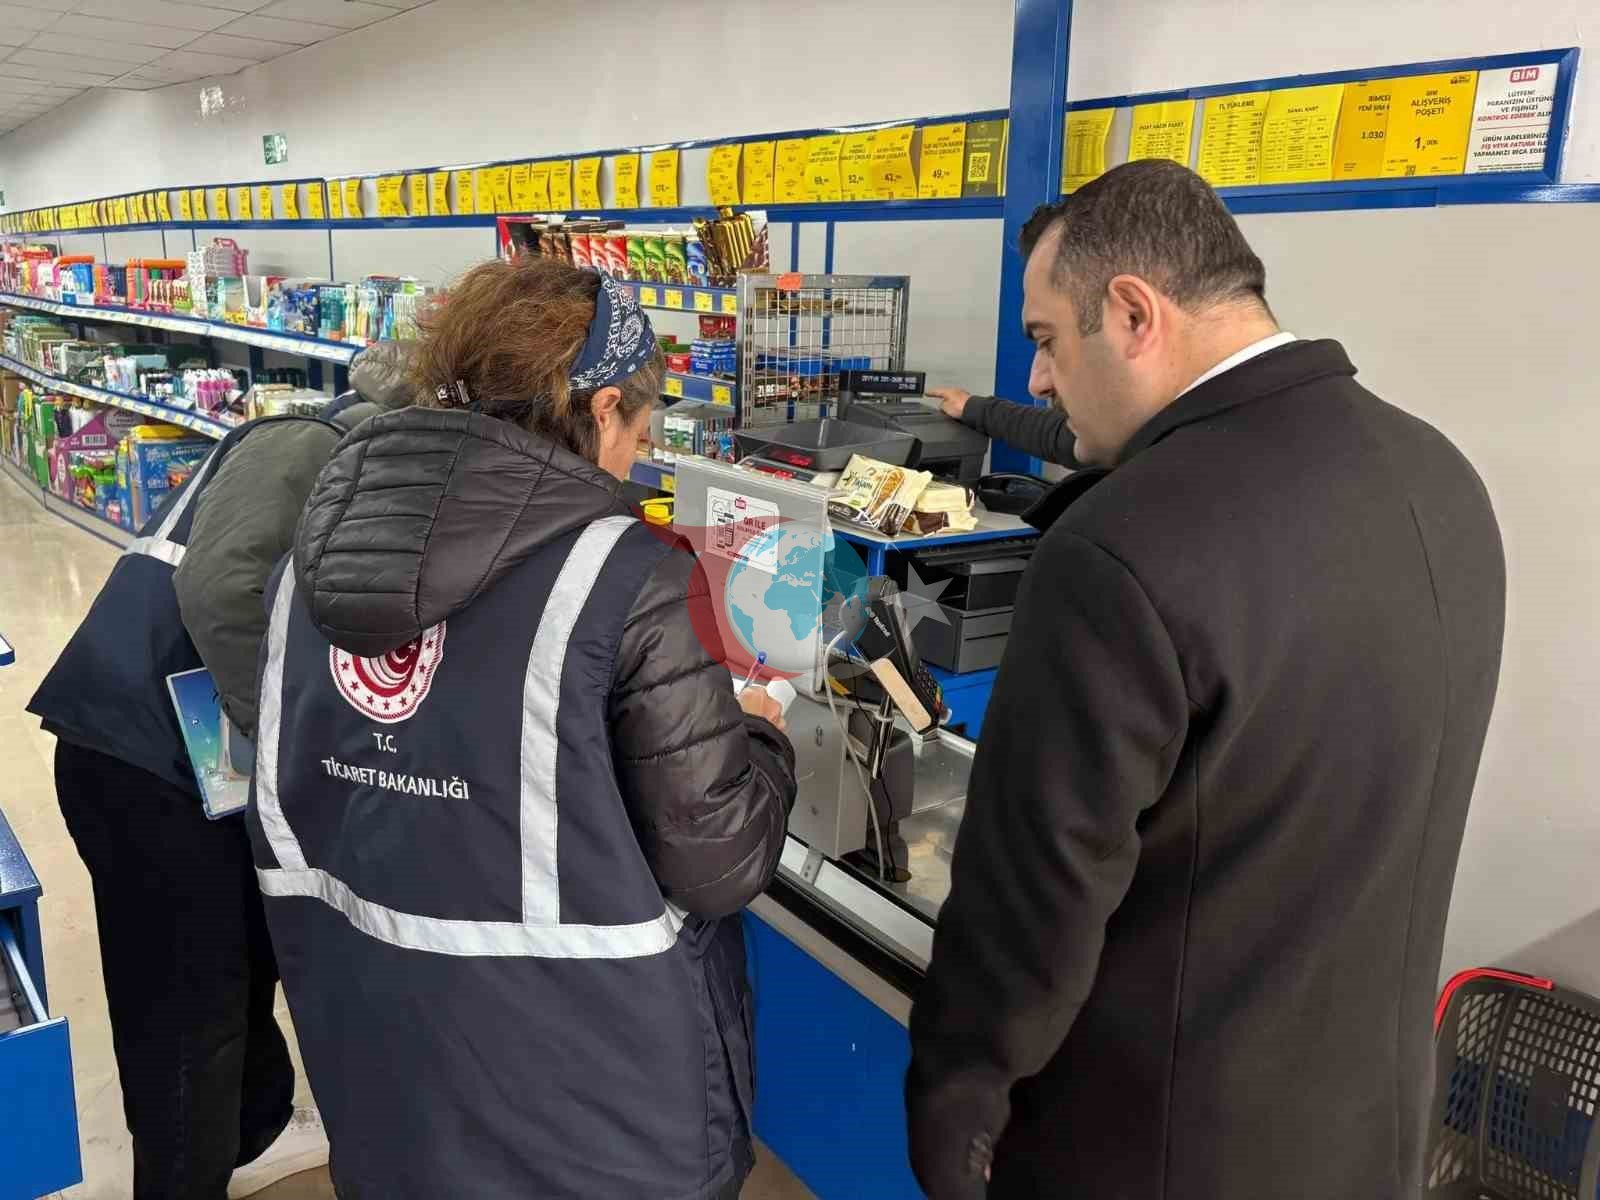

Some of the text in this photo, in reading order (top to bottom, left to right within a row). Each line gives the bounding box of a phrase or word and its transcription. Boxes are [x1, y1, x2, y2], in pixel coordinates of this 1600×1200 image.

[1411, 96, 1451, 107] ALIŞVERİŞ
[372, 732, 397, 753] T.C.
[321, 756, 469, 800] TİCARET BAKANLIĞI
